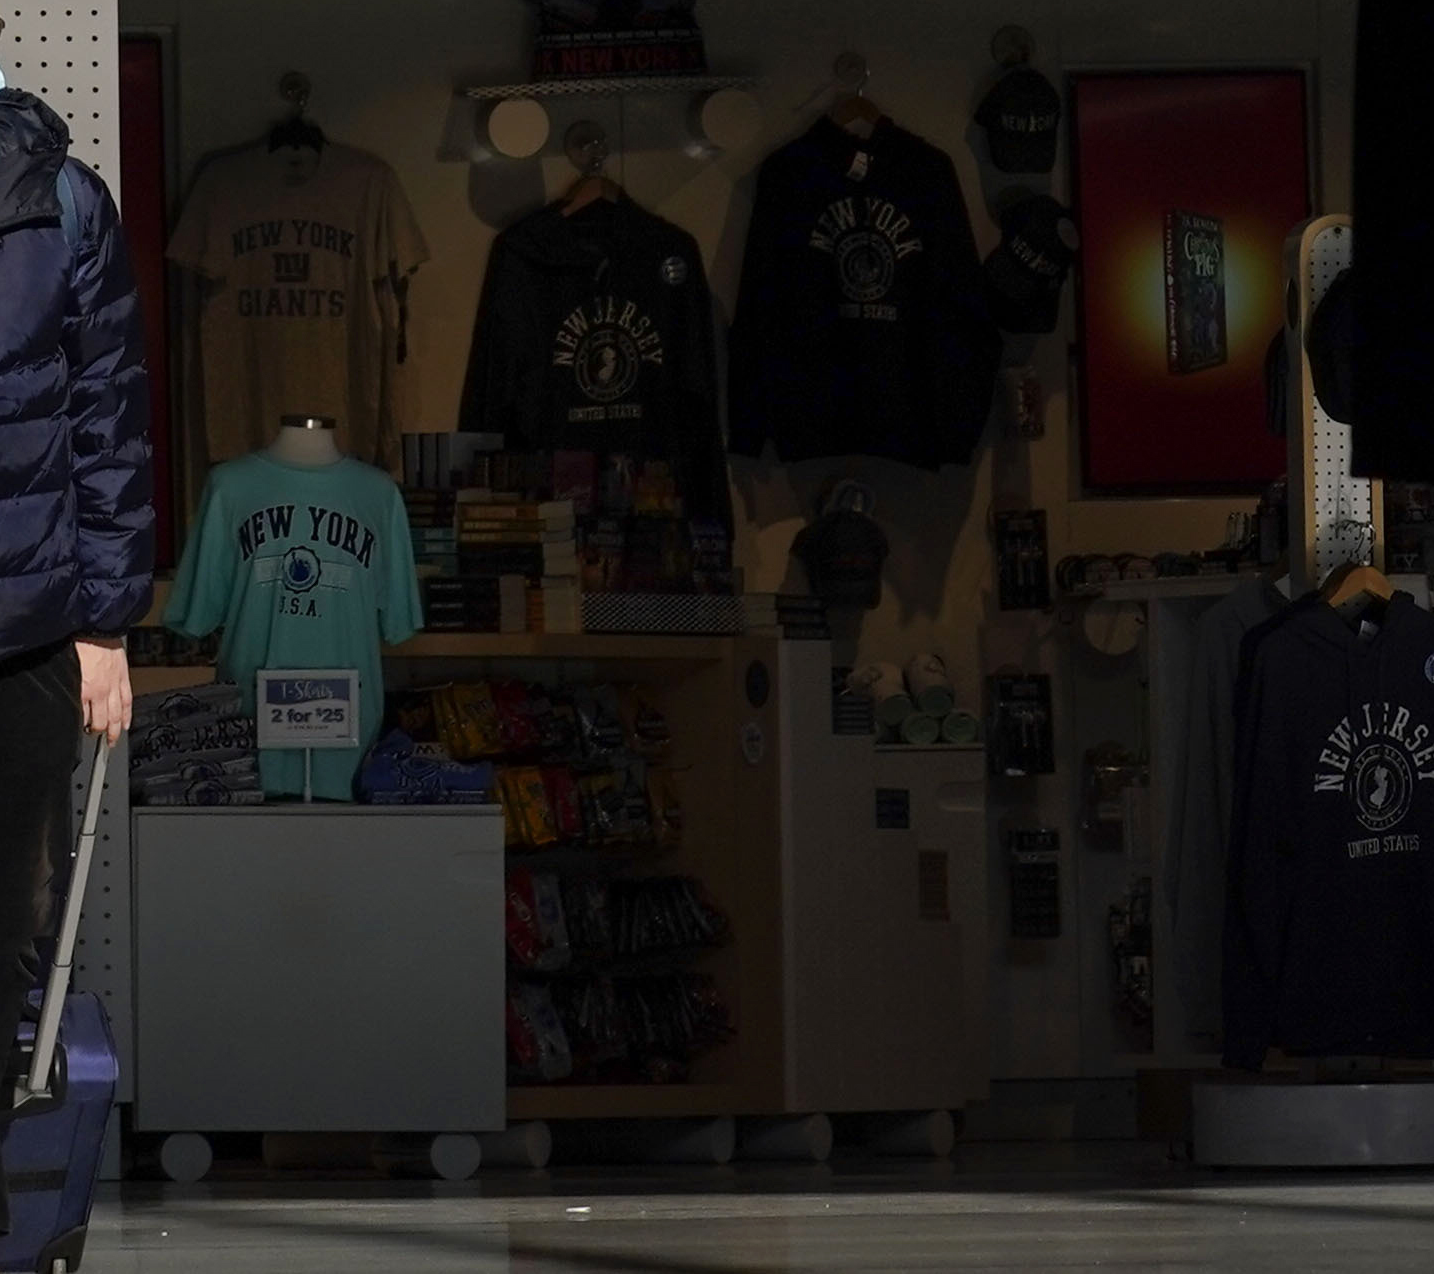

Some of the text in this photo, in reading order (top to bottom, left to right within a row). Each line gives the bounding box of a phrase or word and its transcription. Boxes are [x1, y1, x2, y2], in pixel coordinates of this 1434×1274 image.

[232, 219, 355, 258] NEW YORK
[863, 194, 925, 265] YORK
[238, 289, 345, 318] GIANTS
[551, 294, 665, 368] NEW JERSEY
[238, 505, 376, 569] NEW YORK
[271, 708, 344, 722] 2 for $25
[1314, 715, 1358, 793] NEW
